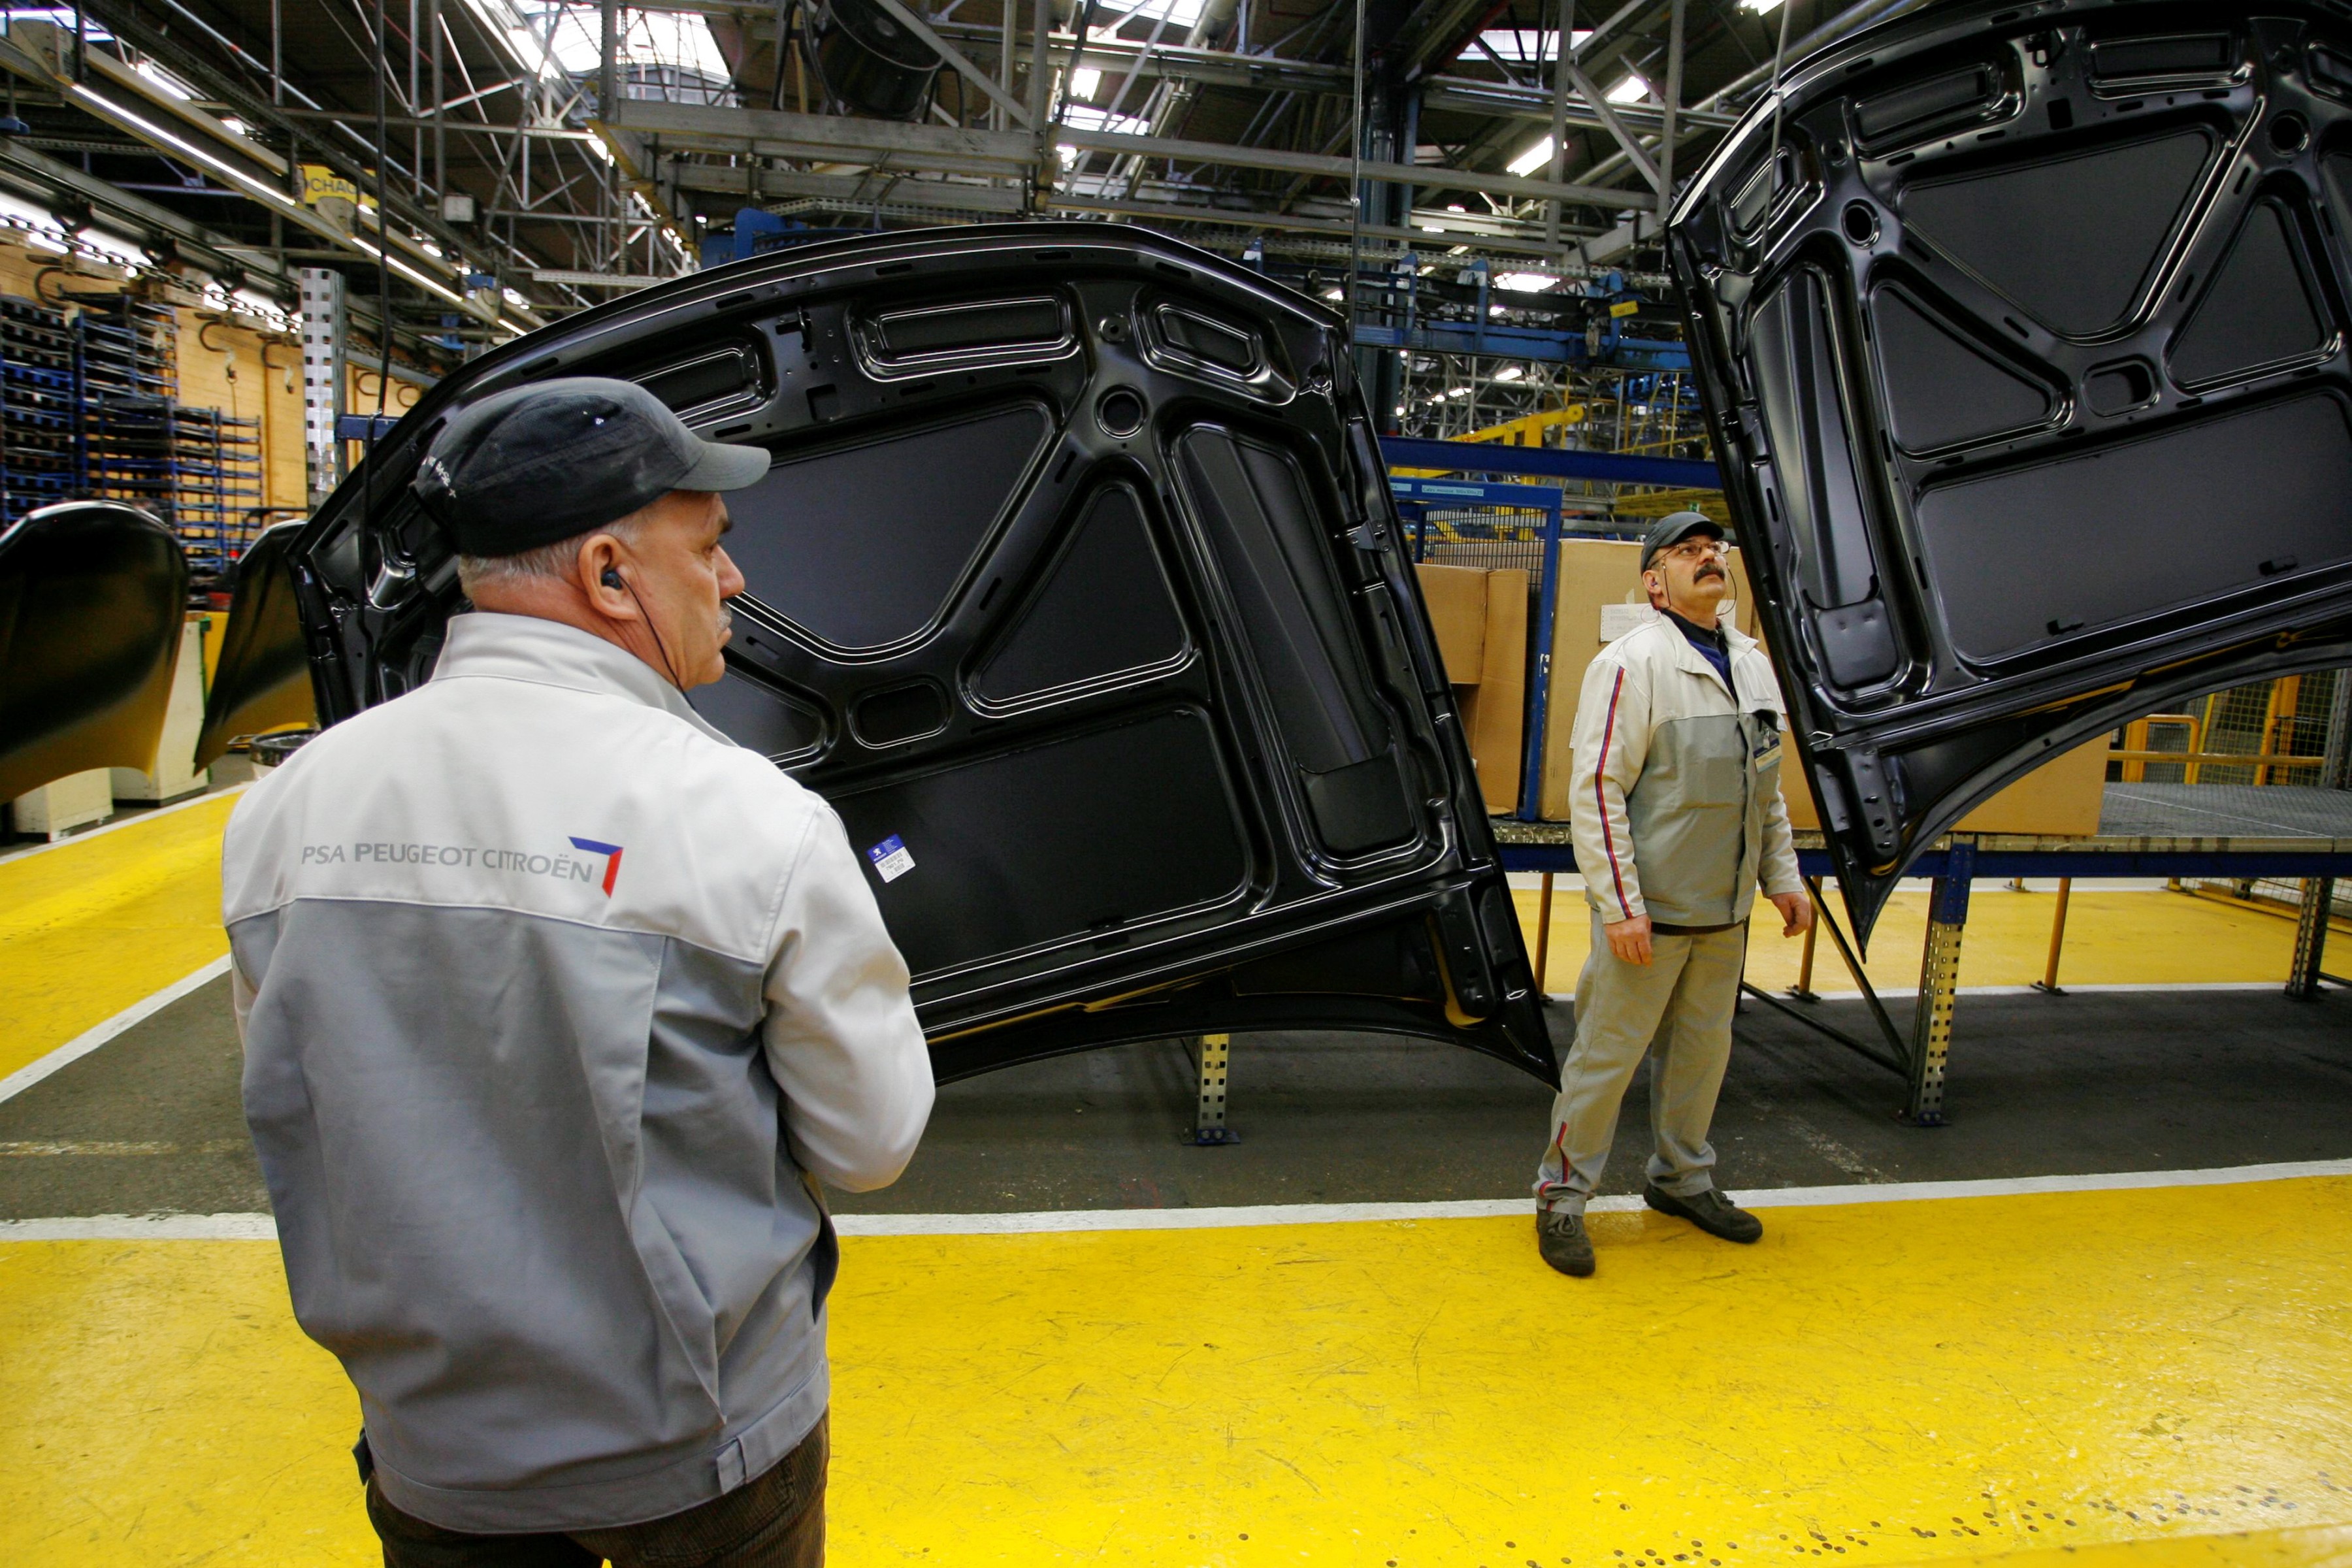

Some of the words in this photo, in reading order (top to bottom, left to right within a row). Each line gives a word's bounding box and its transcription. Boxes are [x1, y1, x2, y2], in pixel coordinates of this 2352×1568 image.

[301, 844, 346, 864] PSA
[355, 843, 478, 867] PEUGEOT
[482, 849, 593, 883] CITROËN
